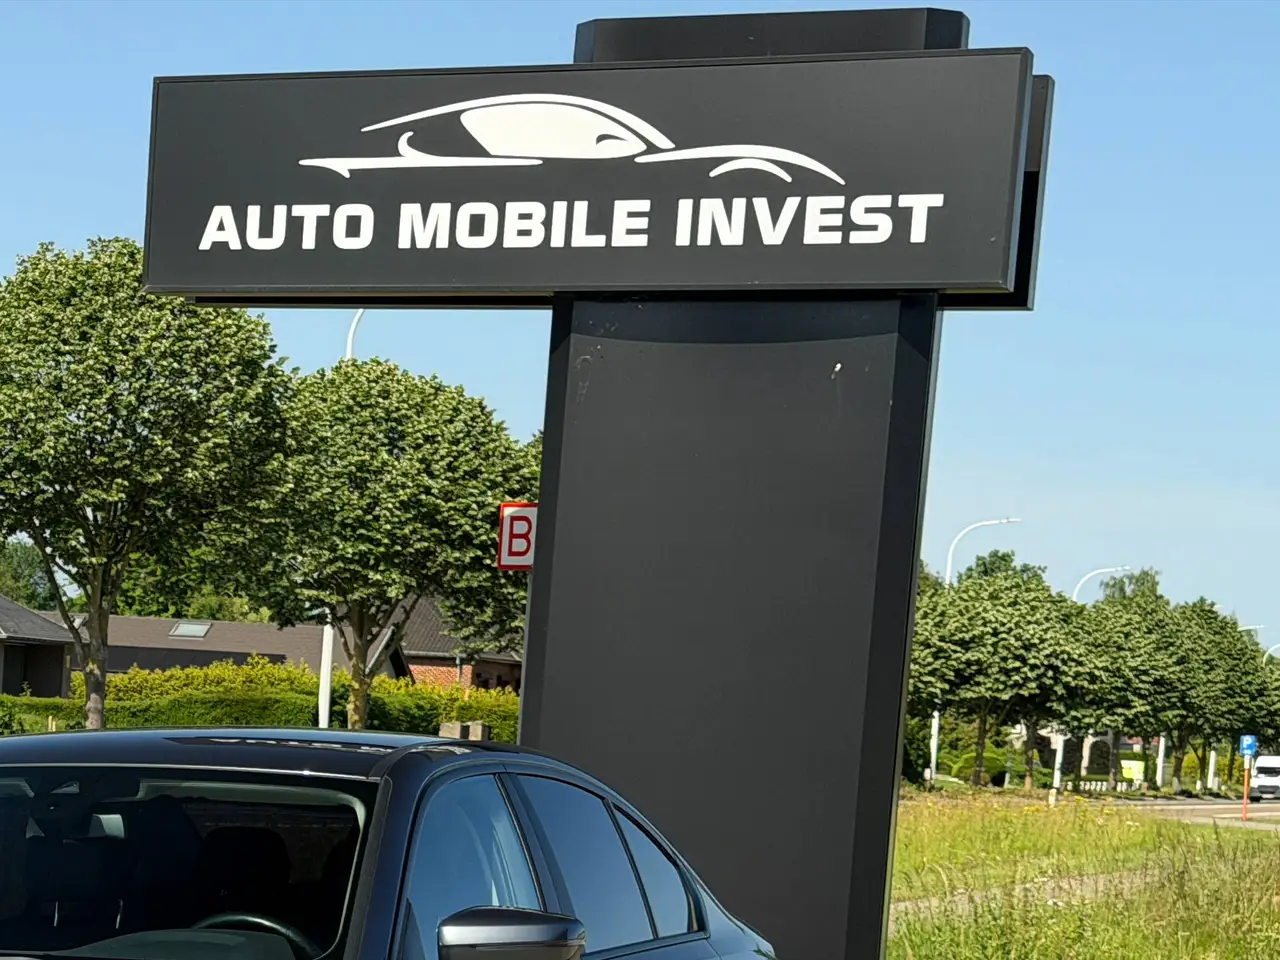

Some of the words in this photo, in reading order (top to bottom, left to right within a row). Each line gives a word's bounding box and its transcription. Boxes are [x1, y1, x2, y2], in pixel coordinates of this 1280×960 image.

[198, 203, 375, 251] AUTO
[397, 200, 652, 249] MOBILE
[675, 193, 945, 247] INVEST
[507, 515, 533, 557] B
[1243, 735, 1253, 748] P
